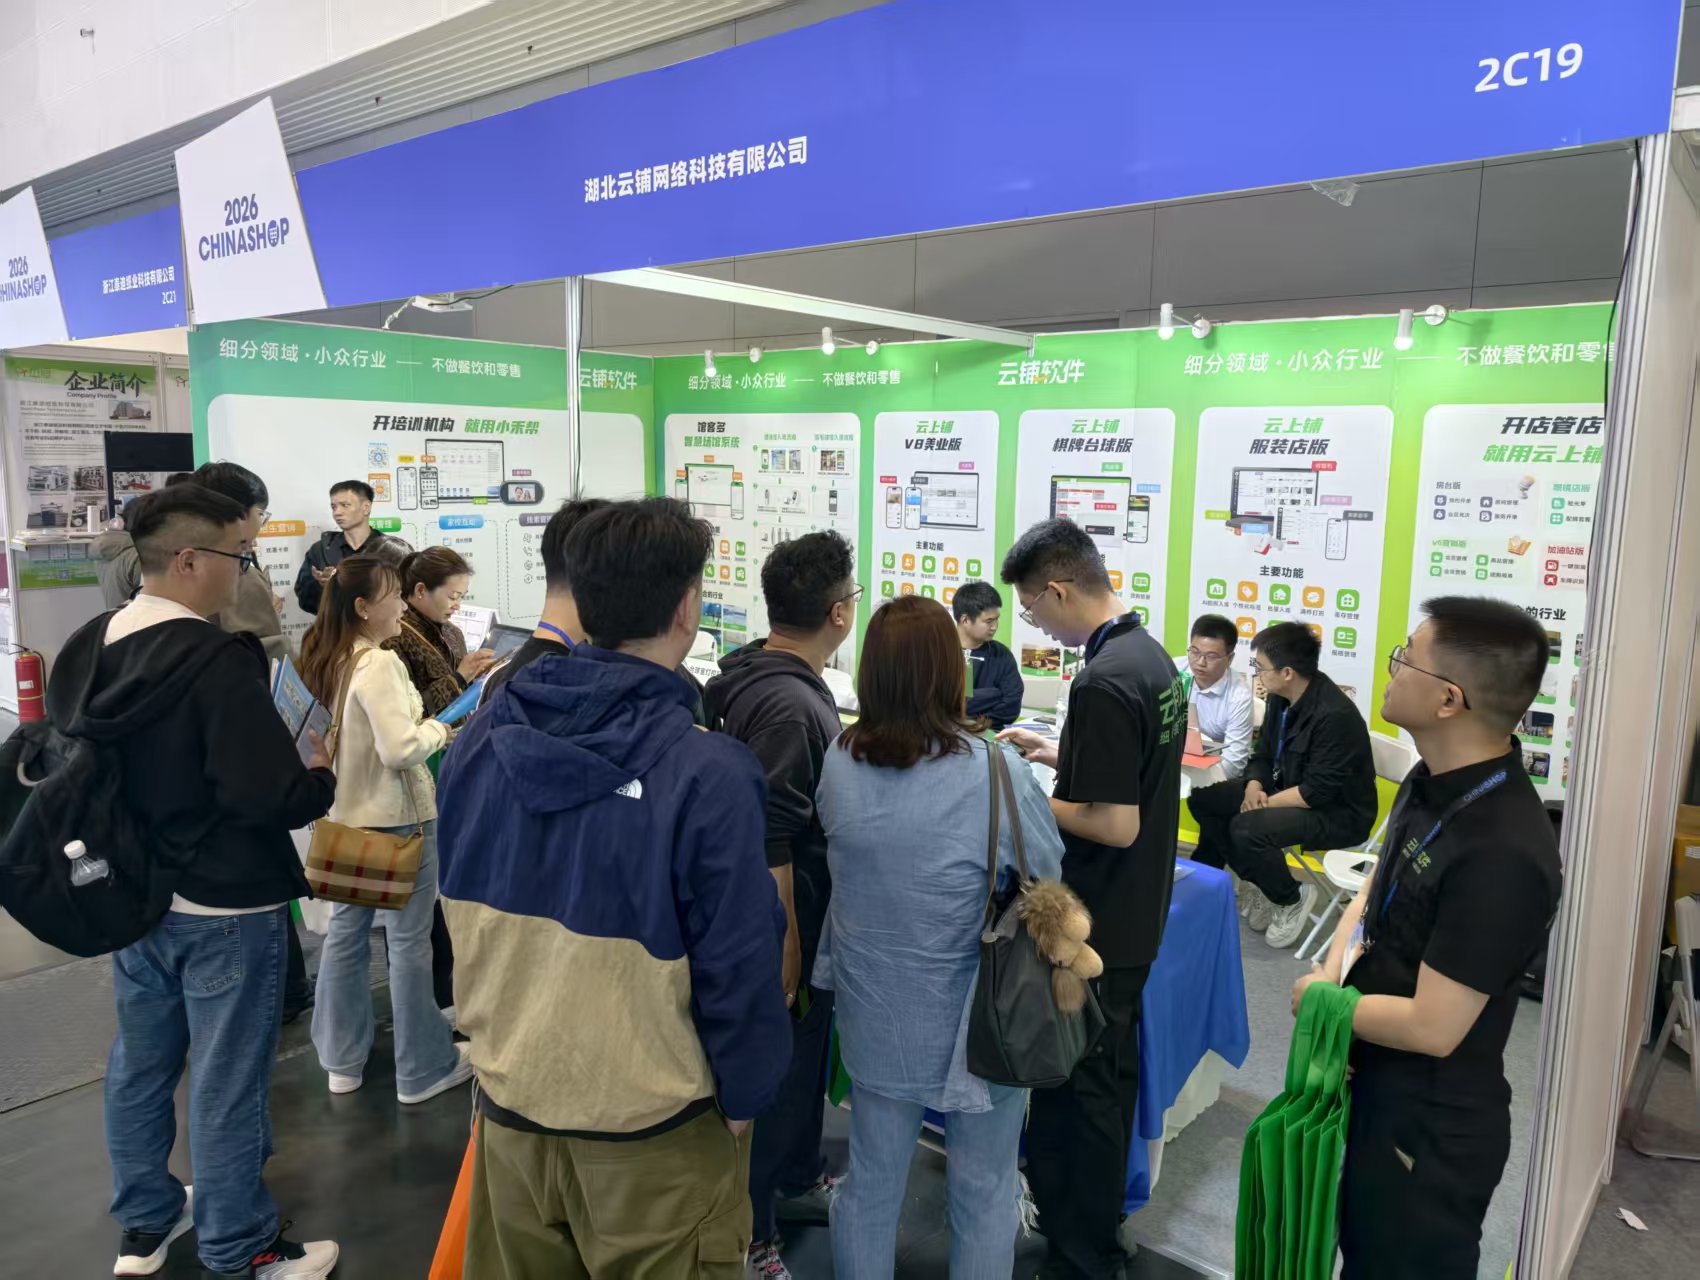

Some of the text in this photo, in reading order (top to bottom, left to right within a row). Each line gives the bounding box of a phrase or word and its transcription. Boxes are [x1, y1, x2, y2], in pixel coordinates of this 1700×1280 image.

[1474, 42, 1584, 93] 2C19
[584, 135, 808, 203] 湖北云铺网络科技有限公司
[223, 193, 258, 227] 2026
[198, 217, 290, 261] CHINASHOP
[8, 255, 29, 278] 2026
[431, 357, 522, 378] 不做餐饮和零售
[997, 358, 1085, 386] 云铺软件
[64, 369, 147, 398] 企业简介
[823, 369, 901, 388] 不做餐饮和零售
[66, 391, 97, 400] Company
[372, 415, 540, 435] 开培训机构 就用小禾帮
[915, 420, 954, 434] 云上铺
[1071, 419, 1121, 434] 云上铺
[1263, 417, 1325, 434] 云上铺
[1500, 416, 1605, 435] 开店管店
[684, 436, 742, 449] 智慧场馆系统
[1052, 437, 1134, 453] 棋牌台球版
[1248, 438, 1331, 456] 服装店版
[1482, 444, 1604, 464] 就用云上铺
[915, 540, 945, 552] 主要功能
[1547, 545, 1585, 556] 加油站版
[1259, 565, 1304, 580] 主要功能
